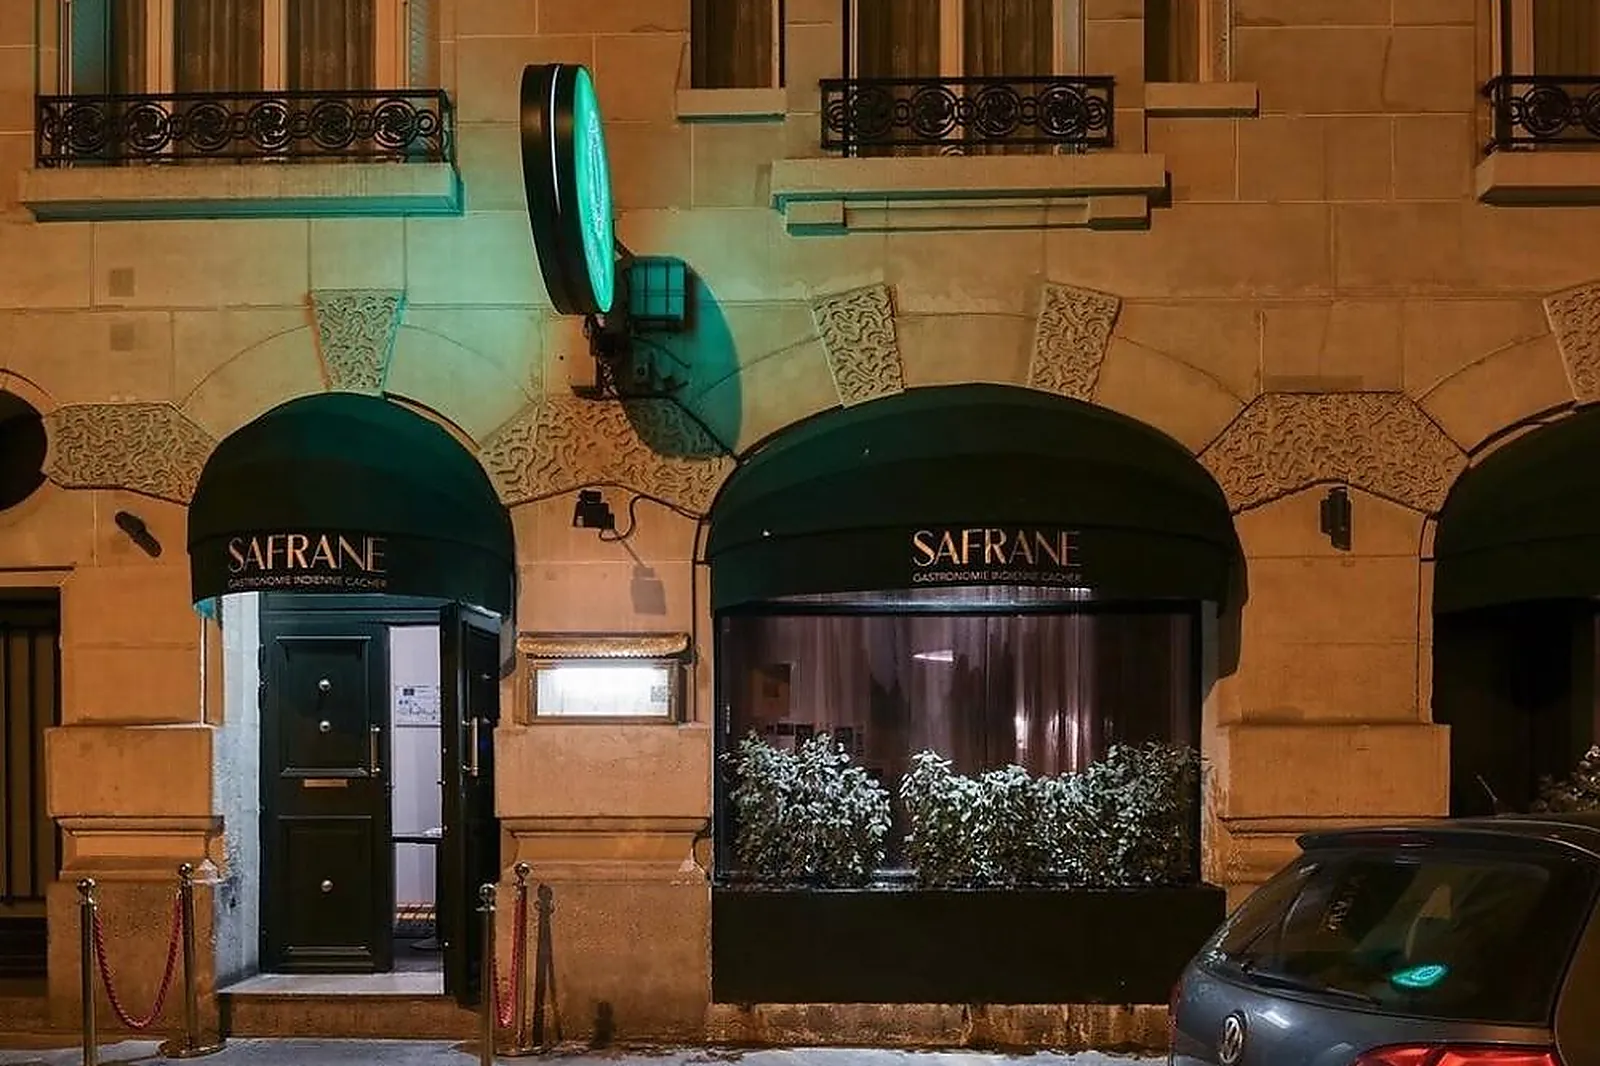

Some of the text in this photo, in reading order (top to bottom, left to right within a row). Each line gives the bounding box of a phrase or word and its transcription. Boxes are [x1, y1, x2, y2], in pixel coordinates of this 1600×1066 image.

[228, 533, 388, 574] SAFRANE
[912, 528, 1082, 567] SAFRANE
[228, 575, 291, 589] GASTRONOMIE
[293, 575, 343, 586] INDIENNE
[912, 571, 988, 583] GASTRONOMIE
